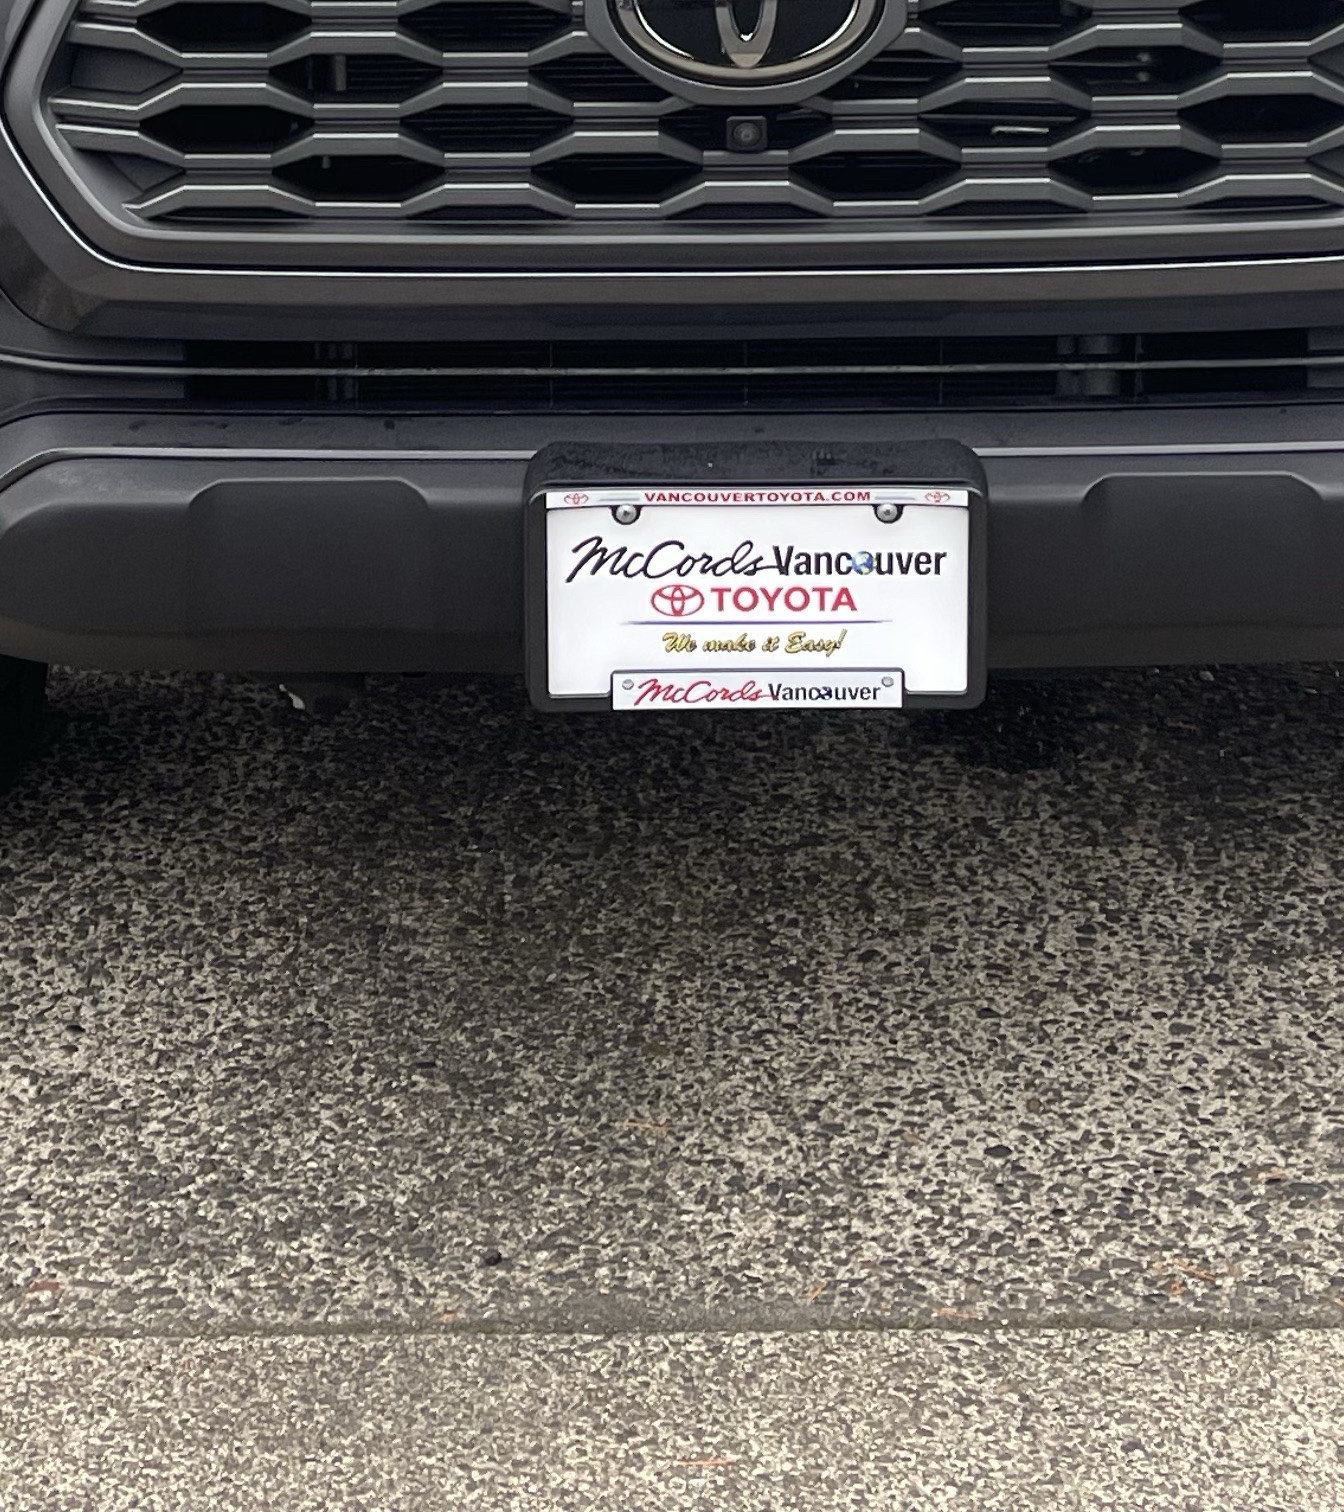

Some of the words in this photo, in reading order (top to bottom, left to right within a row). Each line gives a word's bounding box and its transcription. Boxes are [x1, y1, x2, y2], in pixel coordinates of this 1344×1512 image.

[645, 491, 871, 503] VANCOUVERTOYOTA.COM
[565, 535, 768, 583] McCords
[711, 586, 858, 612] TOYOTA
[662, 631, 697, 653] We
[703, 632, 756, 652] make
[761, 636, 780, 652] it
[784, 628, 848, 658] Easy!
[634, 678, 763, 706] McCords
